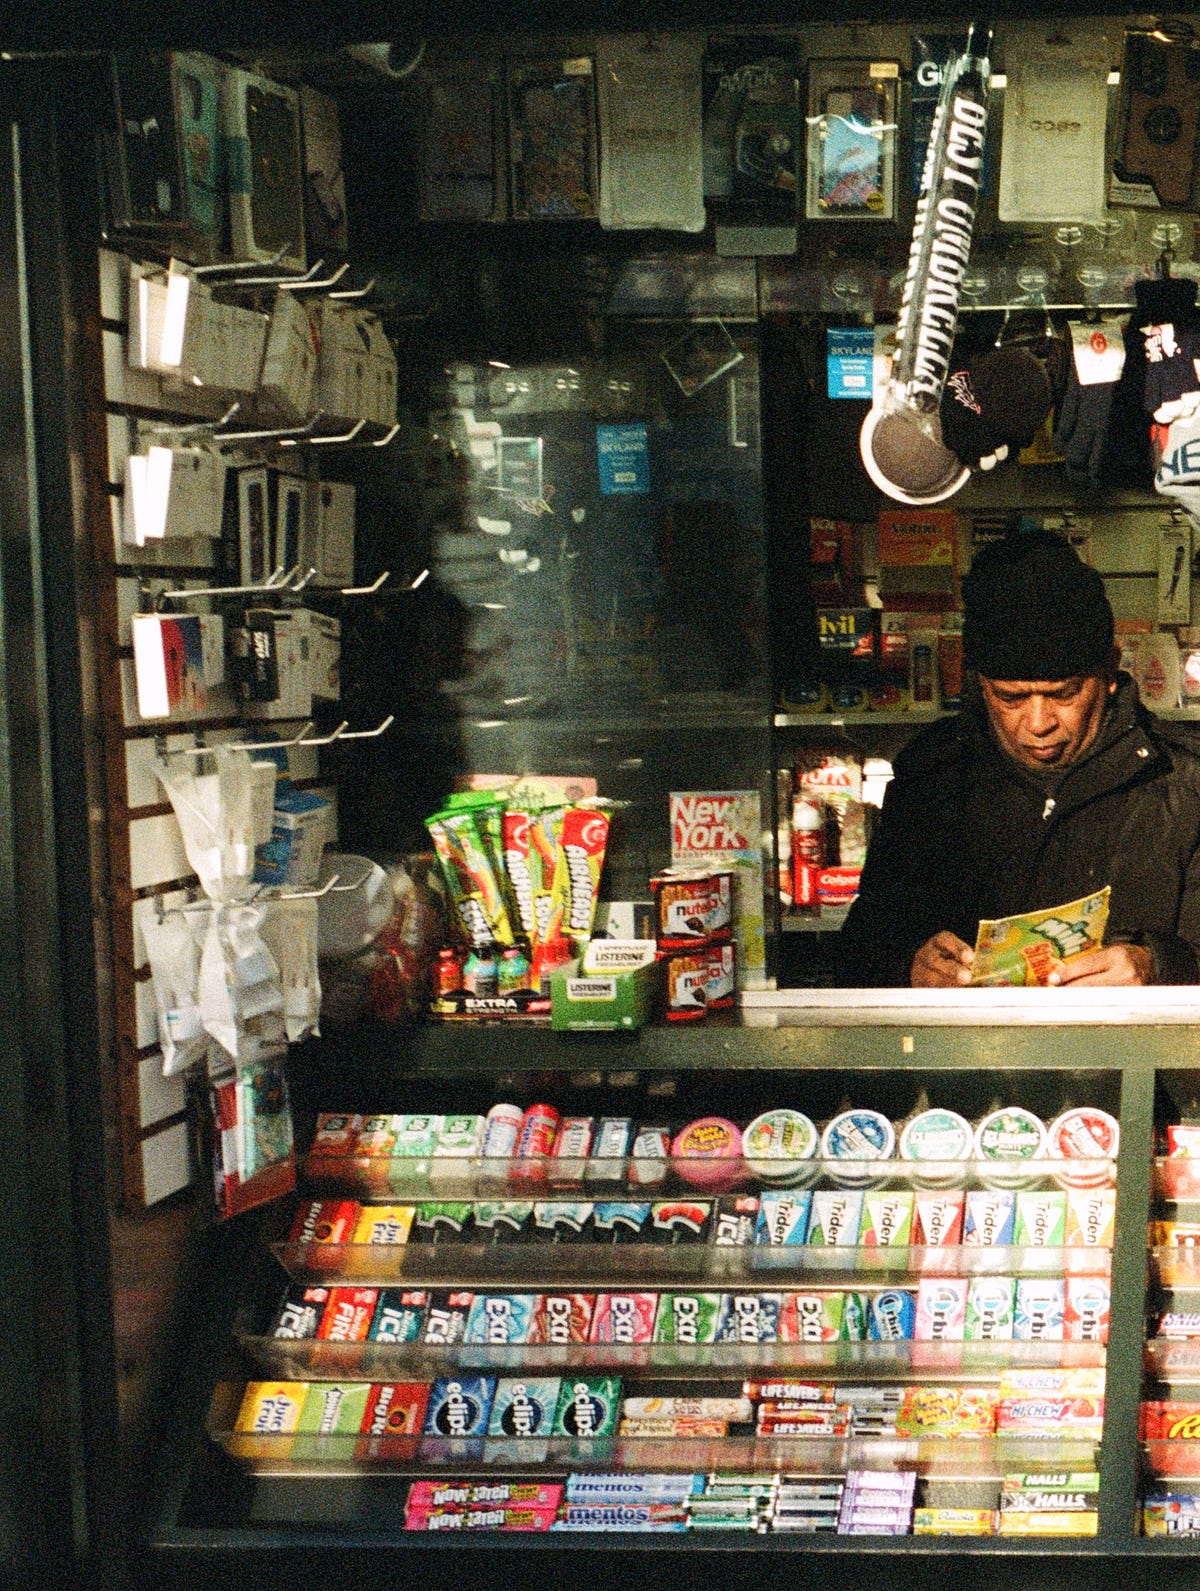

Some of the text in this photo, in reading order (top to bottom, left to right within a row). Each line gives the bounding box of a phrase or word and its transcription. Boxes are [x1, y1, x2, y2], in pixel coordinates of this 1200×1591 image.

[672, 800, 739, 822] New
[675, 822, 742, 850] York
[564, 845, 593, 930] AIRHEADS
[594, 951, 646, 963] LISTERINE
[570, 982, 613, 993] LISTERINE
[465, 999, 518, 1010] EXTRA
[774, 1198, 795, 1245] Triden
[825, 1198, 847, 1245] Triden
[878, 1198, 899, 1245] Triden
[928, 1200, 948, 1245] Triden
[982, 1200, 1000, 1245] Triden
[1032, 1200, 1050, 1245] Triden
[1086, 1200, 1104, 1245] Triden
[574, 1482, 645, 1493] mentos
[1025, 1474, 1068, 1486] HALLS
[567, 1506, 650, 1522] mentos
[1034, 1493, 1087, 1508] HALLS
